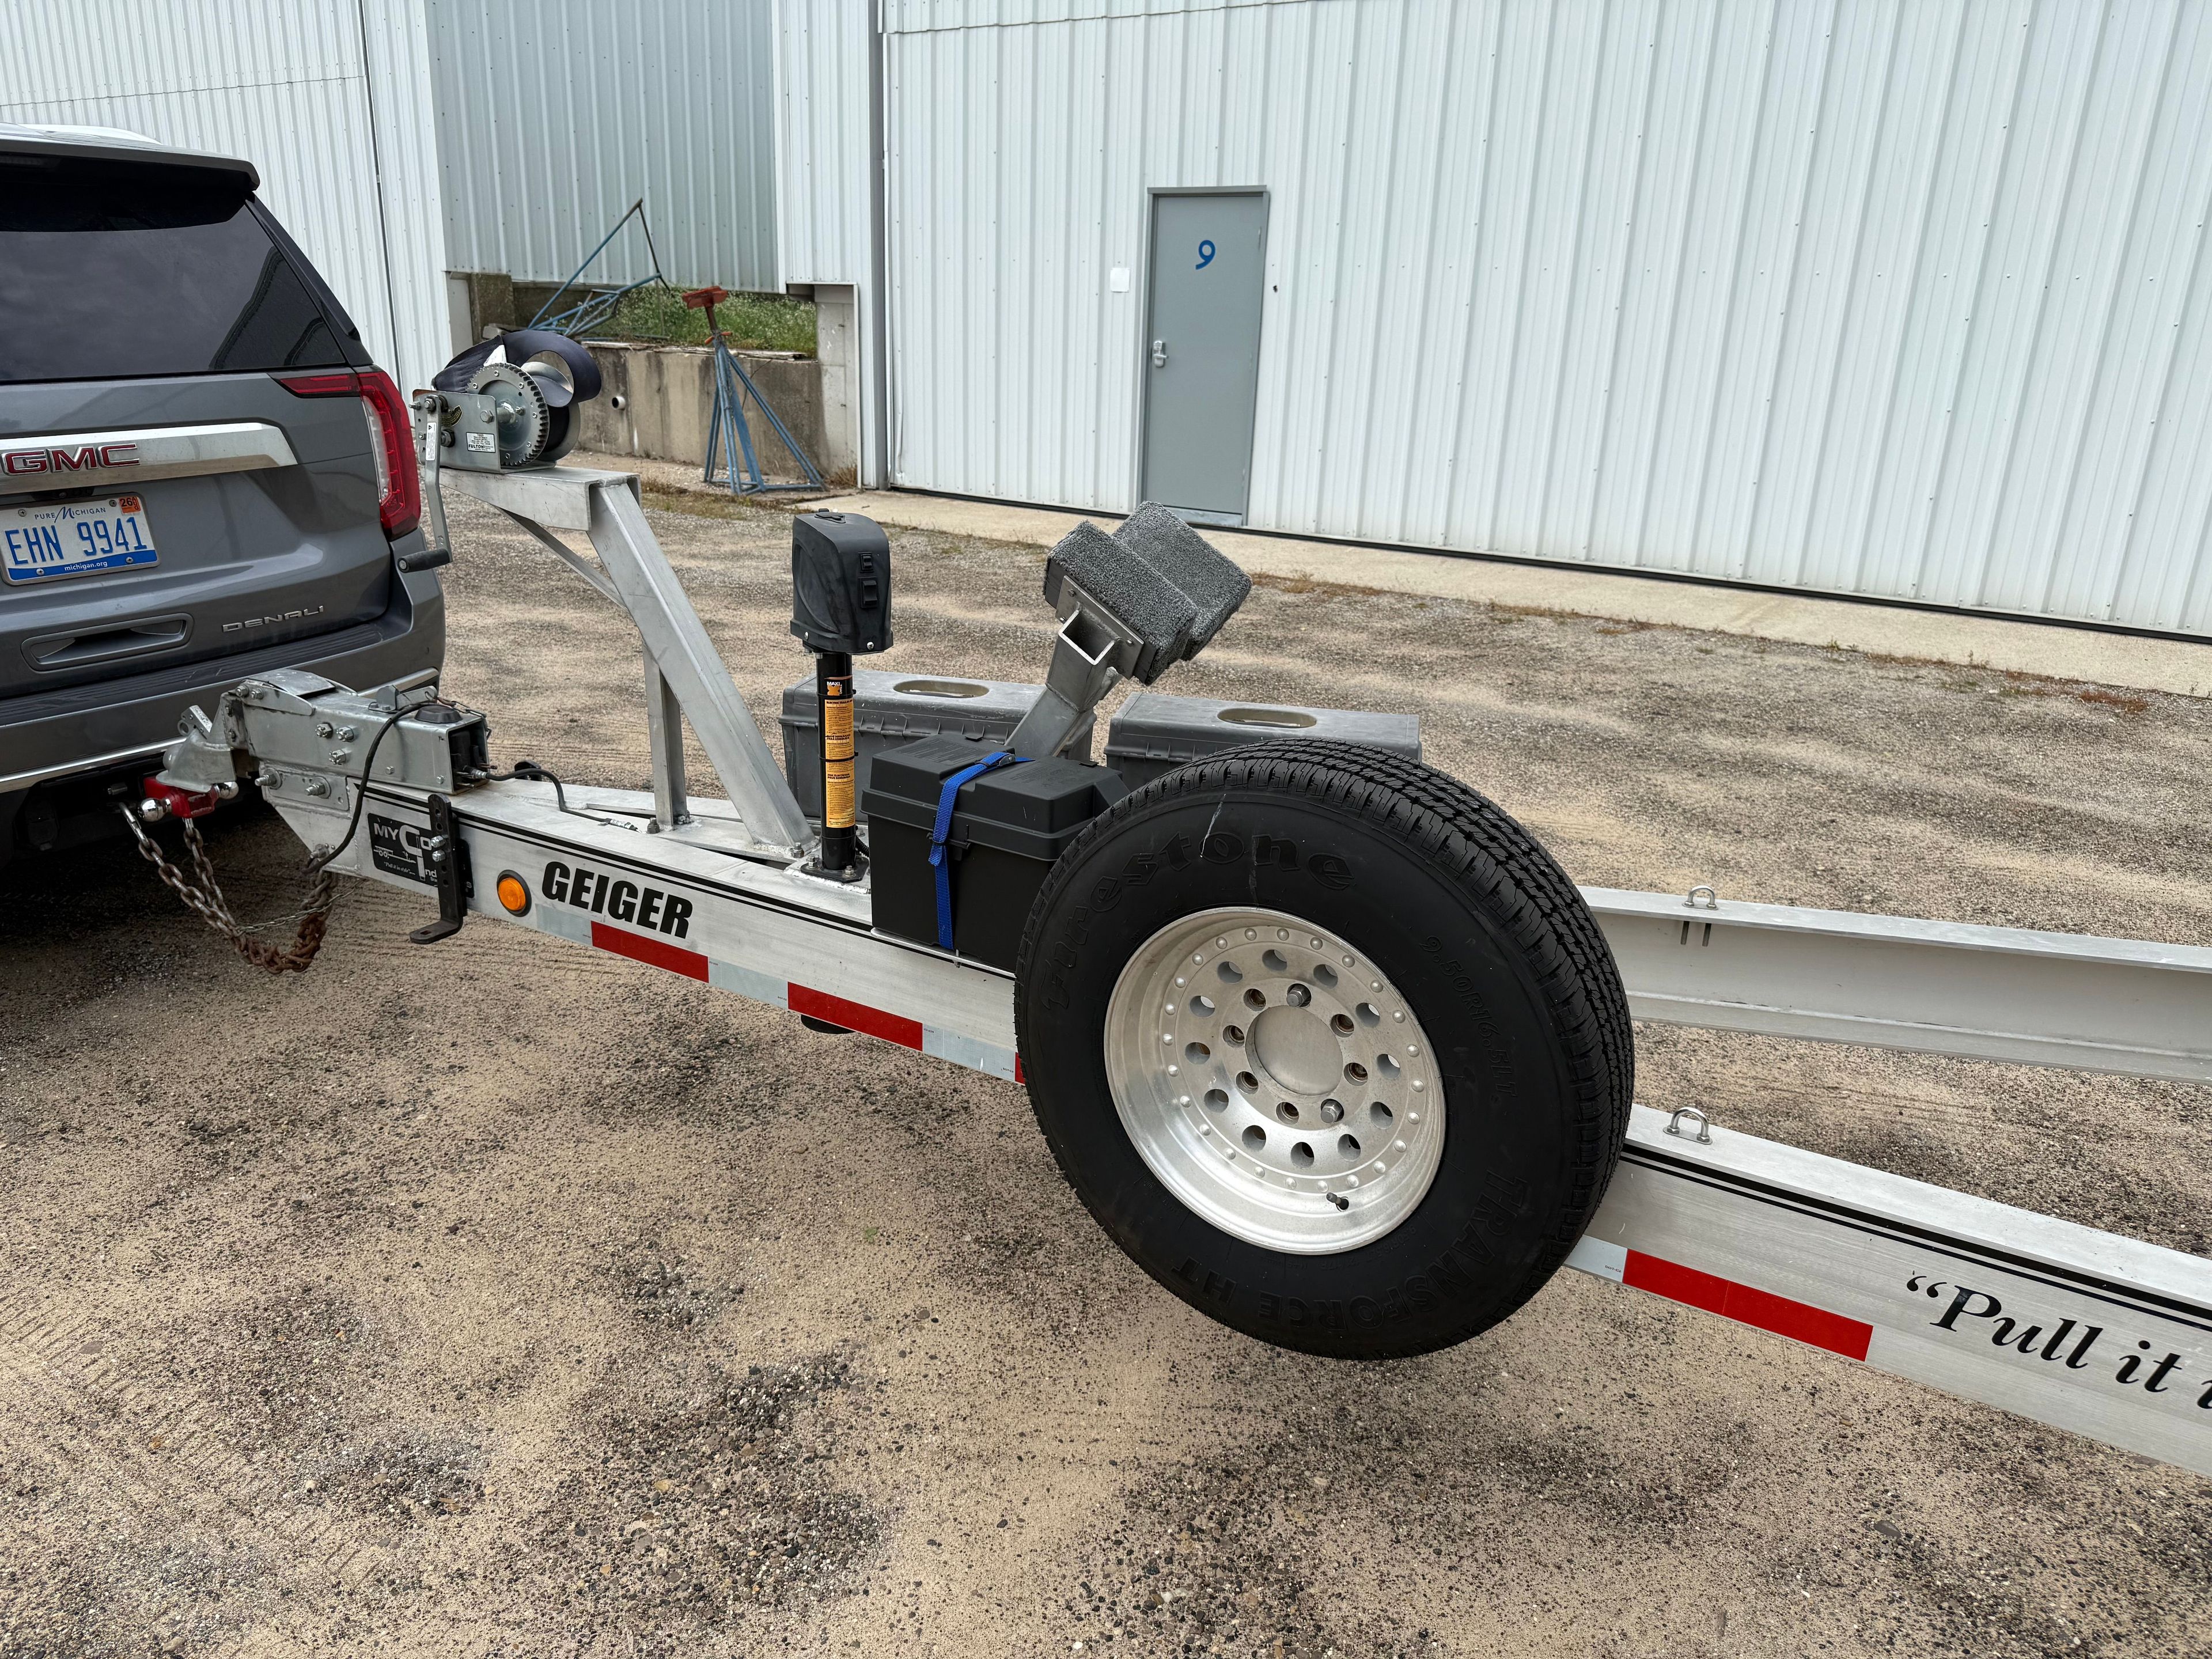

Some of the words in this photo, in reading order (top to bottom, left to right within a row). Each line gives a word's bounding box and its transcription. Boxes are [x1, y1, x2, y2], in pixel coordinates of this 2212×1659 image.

[1195, 240, 1216, 270] 9
[1, 443, 140, 476] GMC
[54, 506, 106, 522] MICHIGAN
[119, 498, 133, 507] 26
[5, 525, 64, 566] EHN
[77, 516, 147, 556] 9941
[65, 561, 108, 571] michigan.org
[222, 605, 324, 632] DENALI
[541, 860, 693, 939] GEIGER
[1040, 831, 1355, 1010] Firestone
[1419, 934, 1519, 1097] 9.50R16.5LT
[1257, 1166, 1529, 1333] TRANSFORCE
[1171, 1255, 1238, 1305] HT
[1906, 1275, 2103, 1369] “Pull
[2115, 1340, 2182, 1393] it
